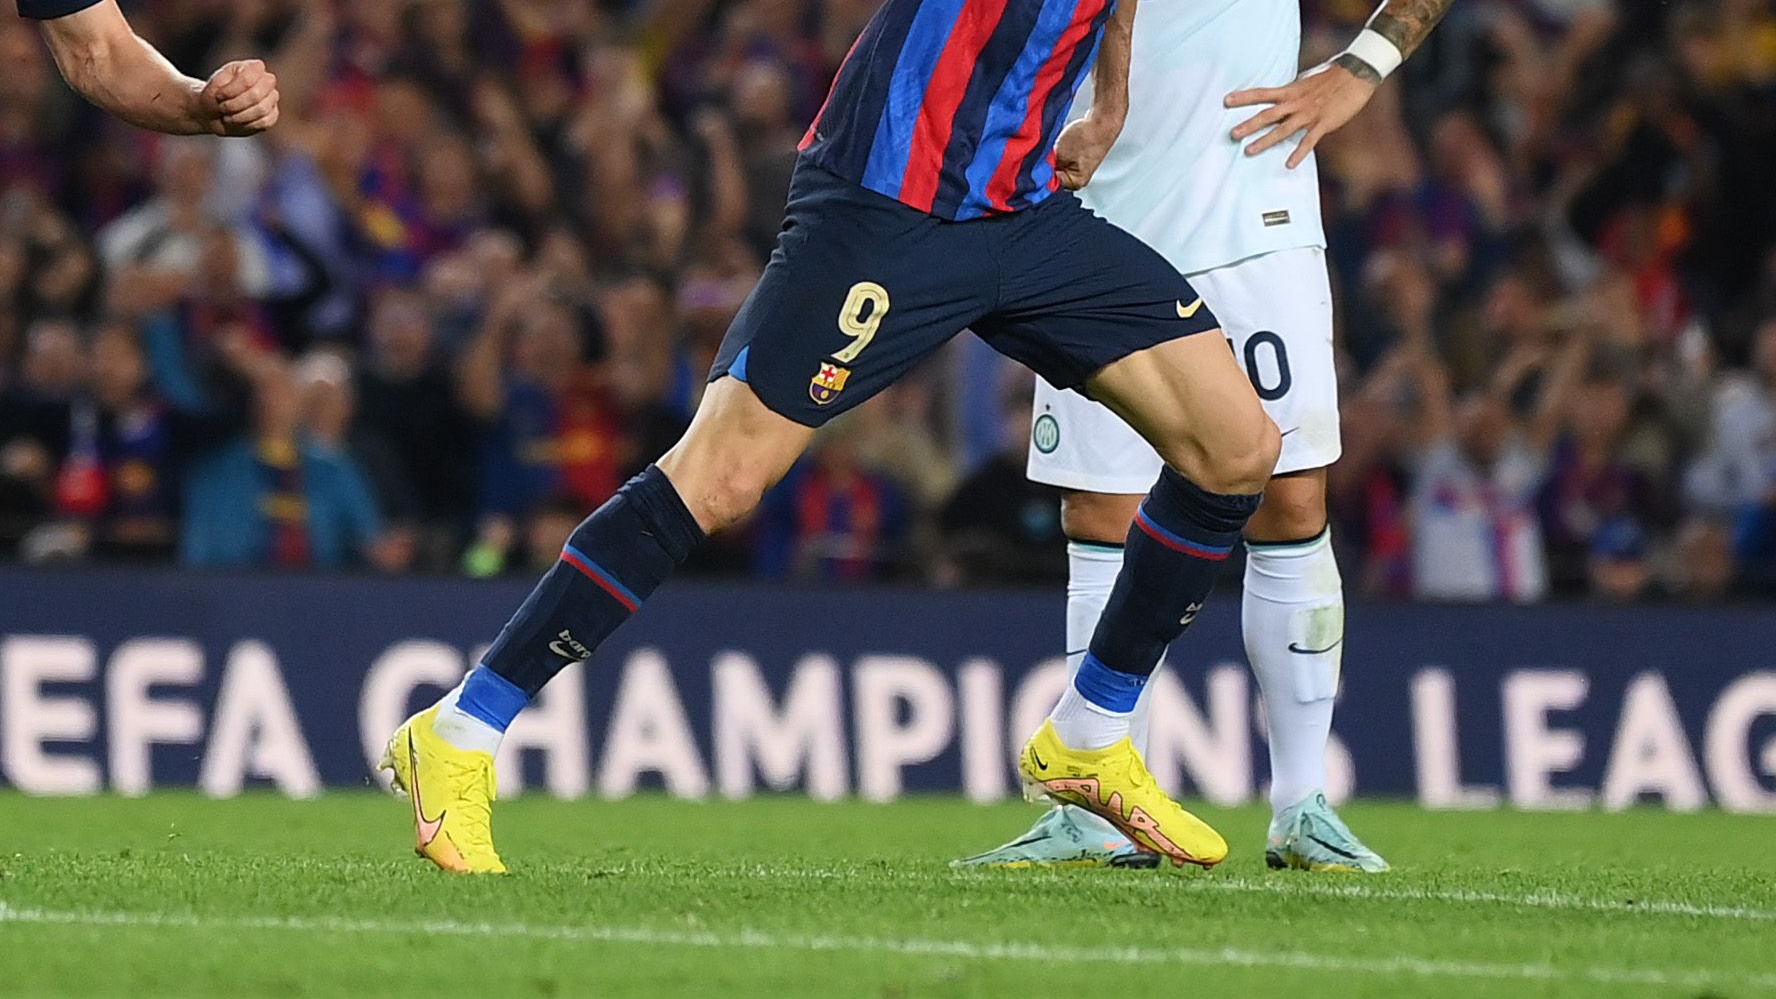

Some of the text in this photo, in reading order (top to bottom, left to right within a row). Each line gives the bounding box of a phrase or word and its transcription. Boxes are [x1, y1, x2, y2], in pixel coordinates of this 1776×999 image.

[829, 281, 891, 363] 9
[1225, 330, 1292, 401] 0
[1411, 667, 1776, 815] LEAG
